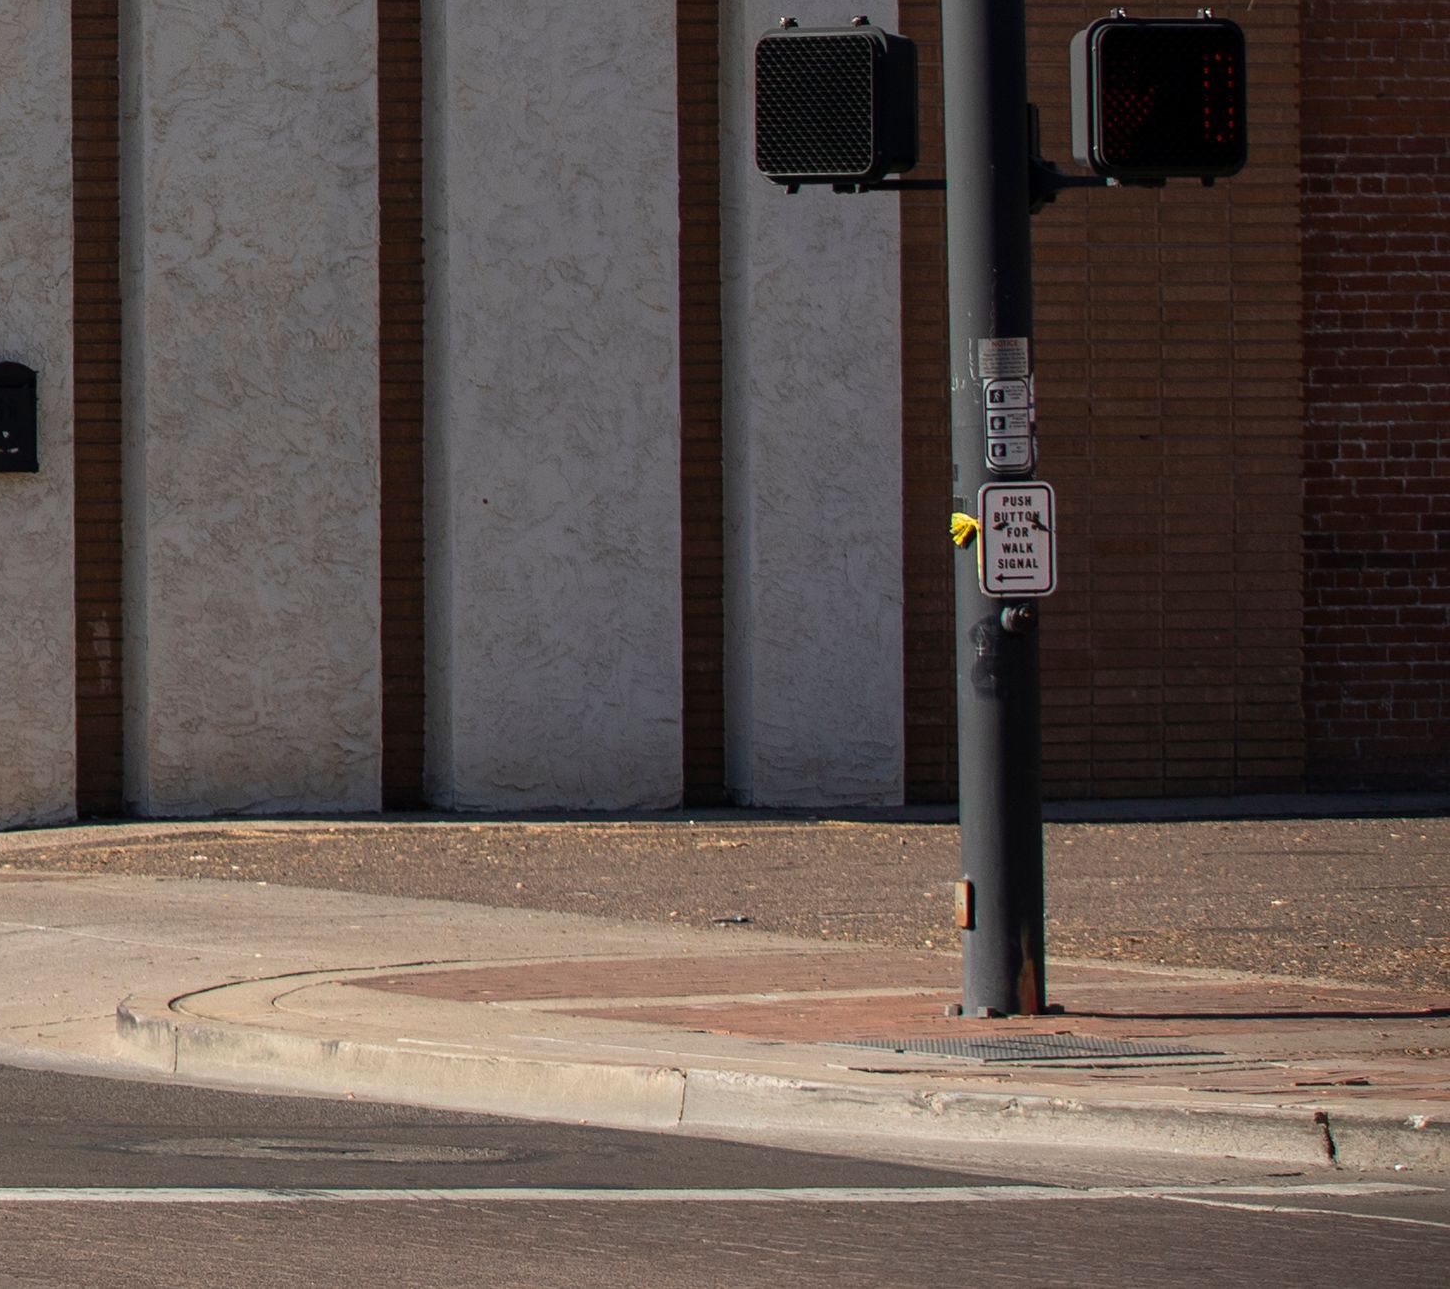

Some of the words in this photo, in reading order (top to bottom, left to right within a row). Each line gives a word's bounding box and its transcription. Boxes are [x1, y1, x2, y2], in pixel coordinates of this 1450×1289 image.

[1002, 496, 1032, 506] PUSH
[994, 511, 1040, 522] BUTTON
[1006, 527, 1029, 537] FOR
[1002, 543, 1034, 553] WALK
[997, 558, 1039, 569] SIGNAL
